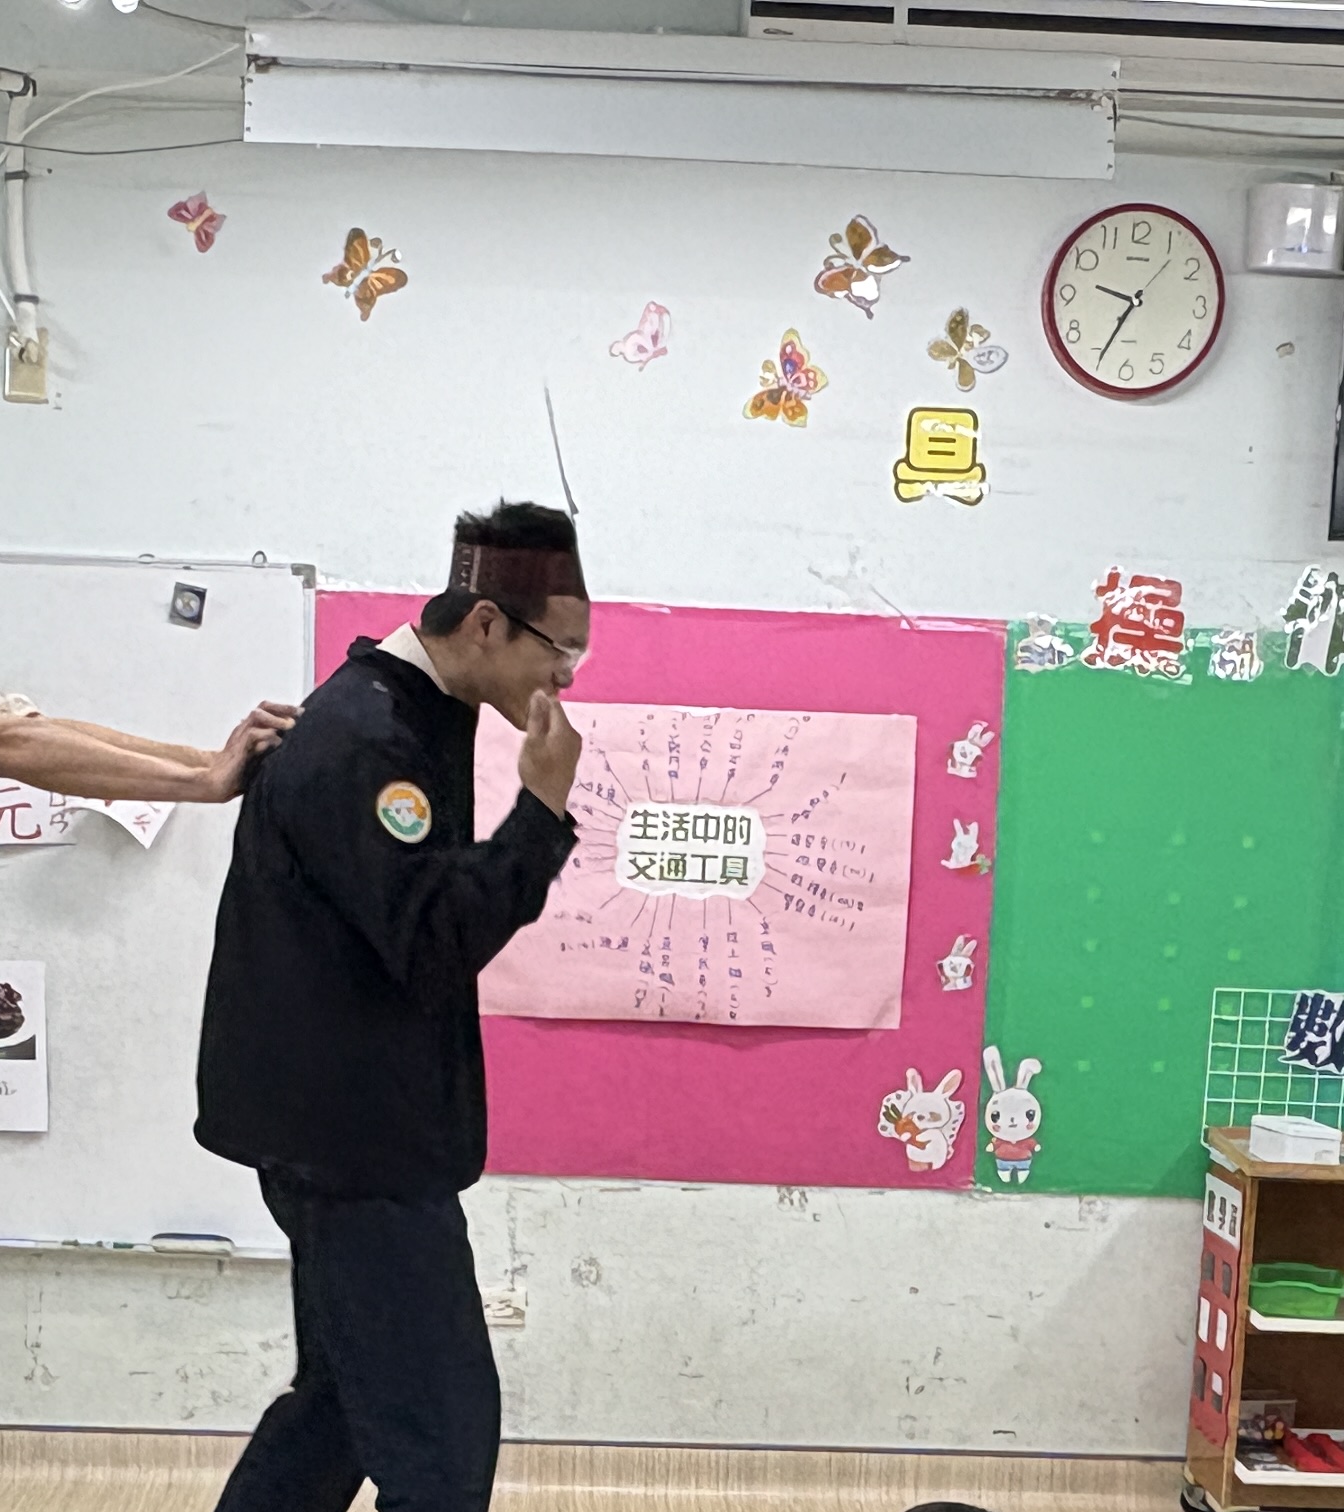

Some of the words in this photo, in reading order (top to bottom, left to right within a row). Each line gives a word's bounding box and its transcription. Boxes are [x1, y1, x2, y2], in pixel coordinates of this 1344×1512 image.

[1101, 224, 1118, 250] 11
[1132, 221, 1152, 246] 12
[1167, 230, 1173, 255] 1
[1075, 246, 1099, 271] 10
[1184, 257, 1201, 280] 2
[1059, 283, 1077, 307] 9
[1192, 295, 1208, 319] 3
[1066, 319, 1081, 344] 8
[1177, 329, 1193, 351] 4
[1118, 358, 1134, 382] 6
[1149, 352, 1165, 375] 5
[630, 810, 753, 846] 生活中的
[628, 853, 749, 886] 交通工具
